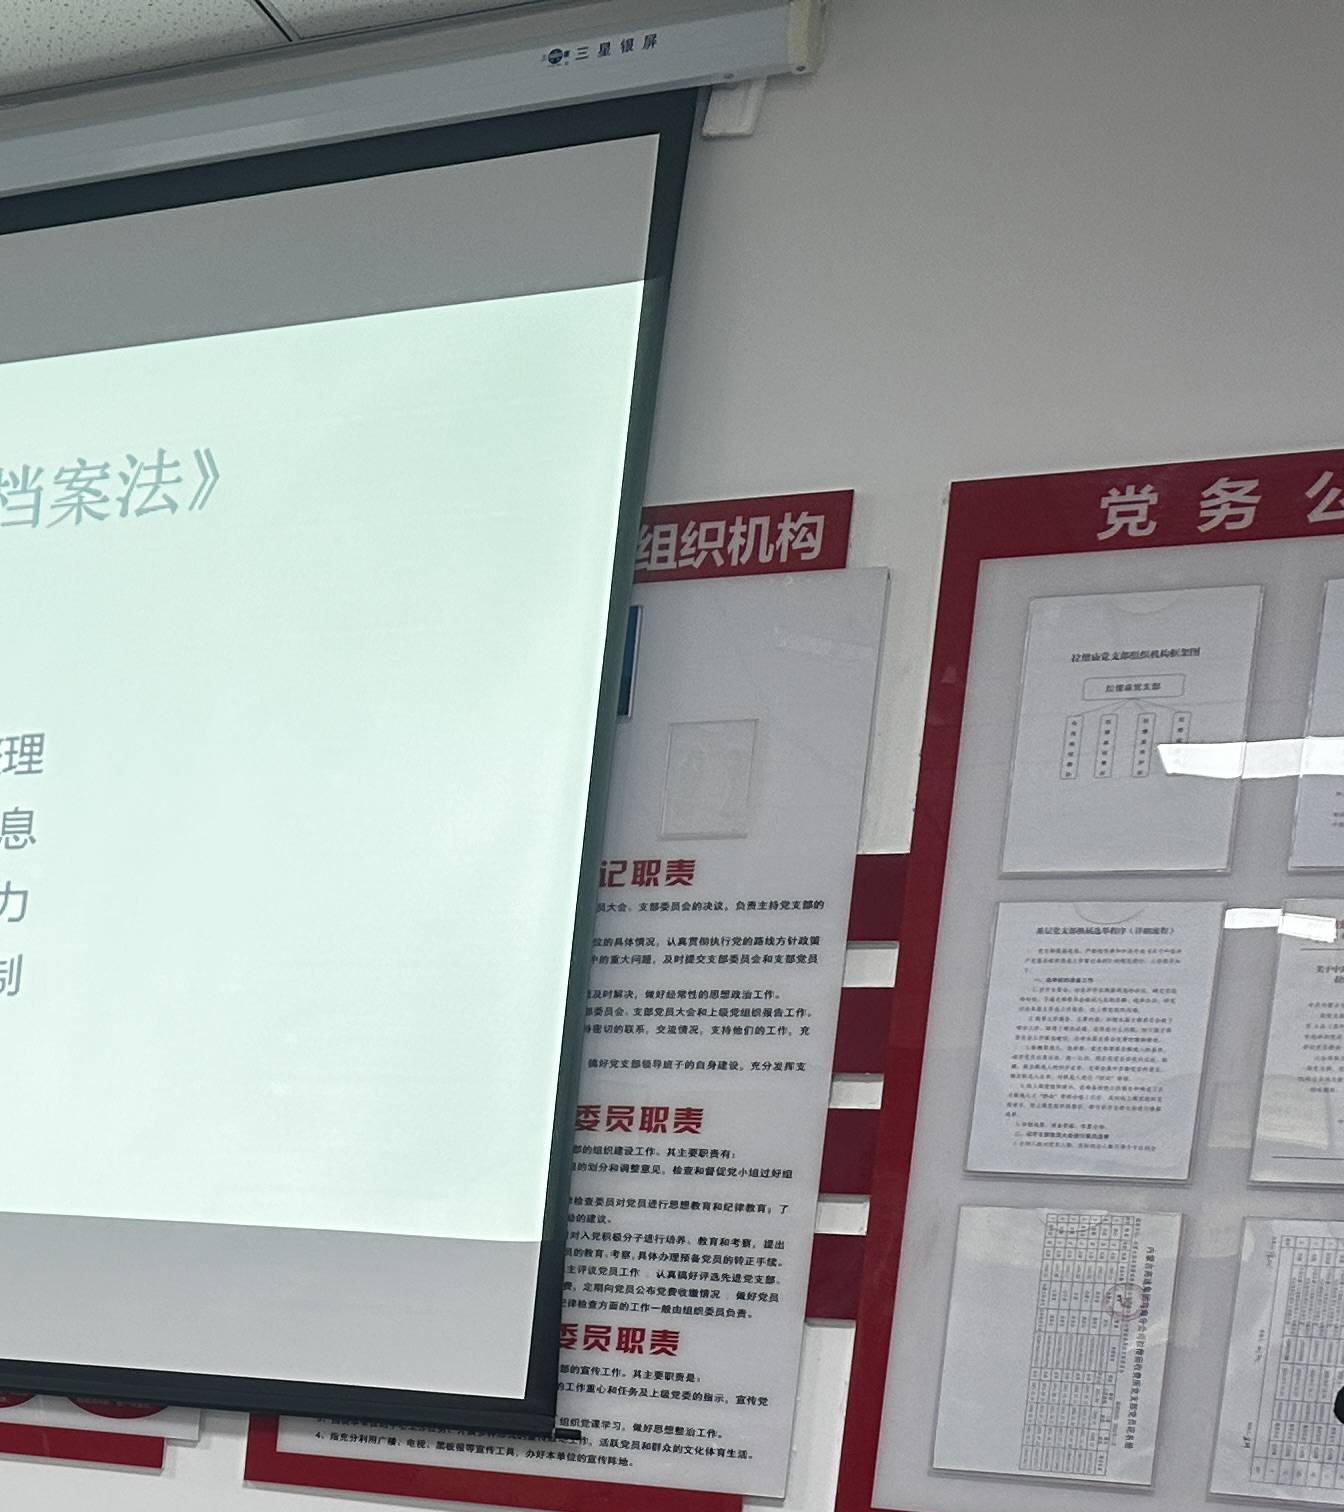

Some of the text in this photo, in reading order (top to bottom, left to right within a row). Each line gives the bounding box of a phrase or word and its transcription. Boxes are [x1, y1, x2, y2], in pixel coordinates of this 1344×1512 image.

[575, 33, 657, 61] 三星银屏
[635, 511, 825, 571] 组织机构
[600, 859, 696, 887] 记职责
[574, 1104, 704, 1136] 委员职责
